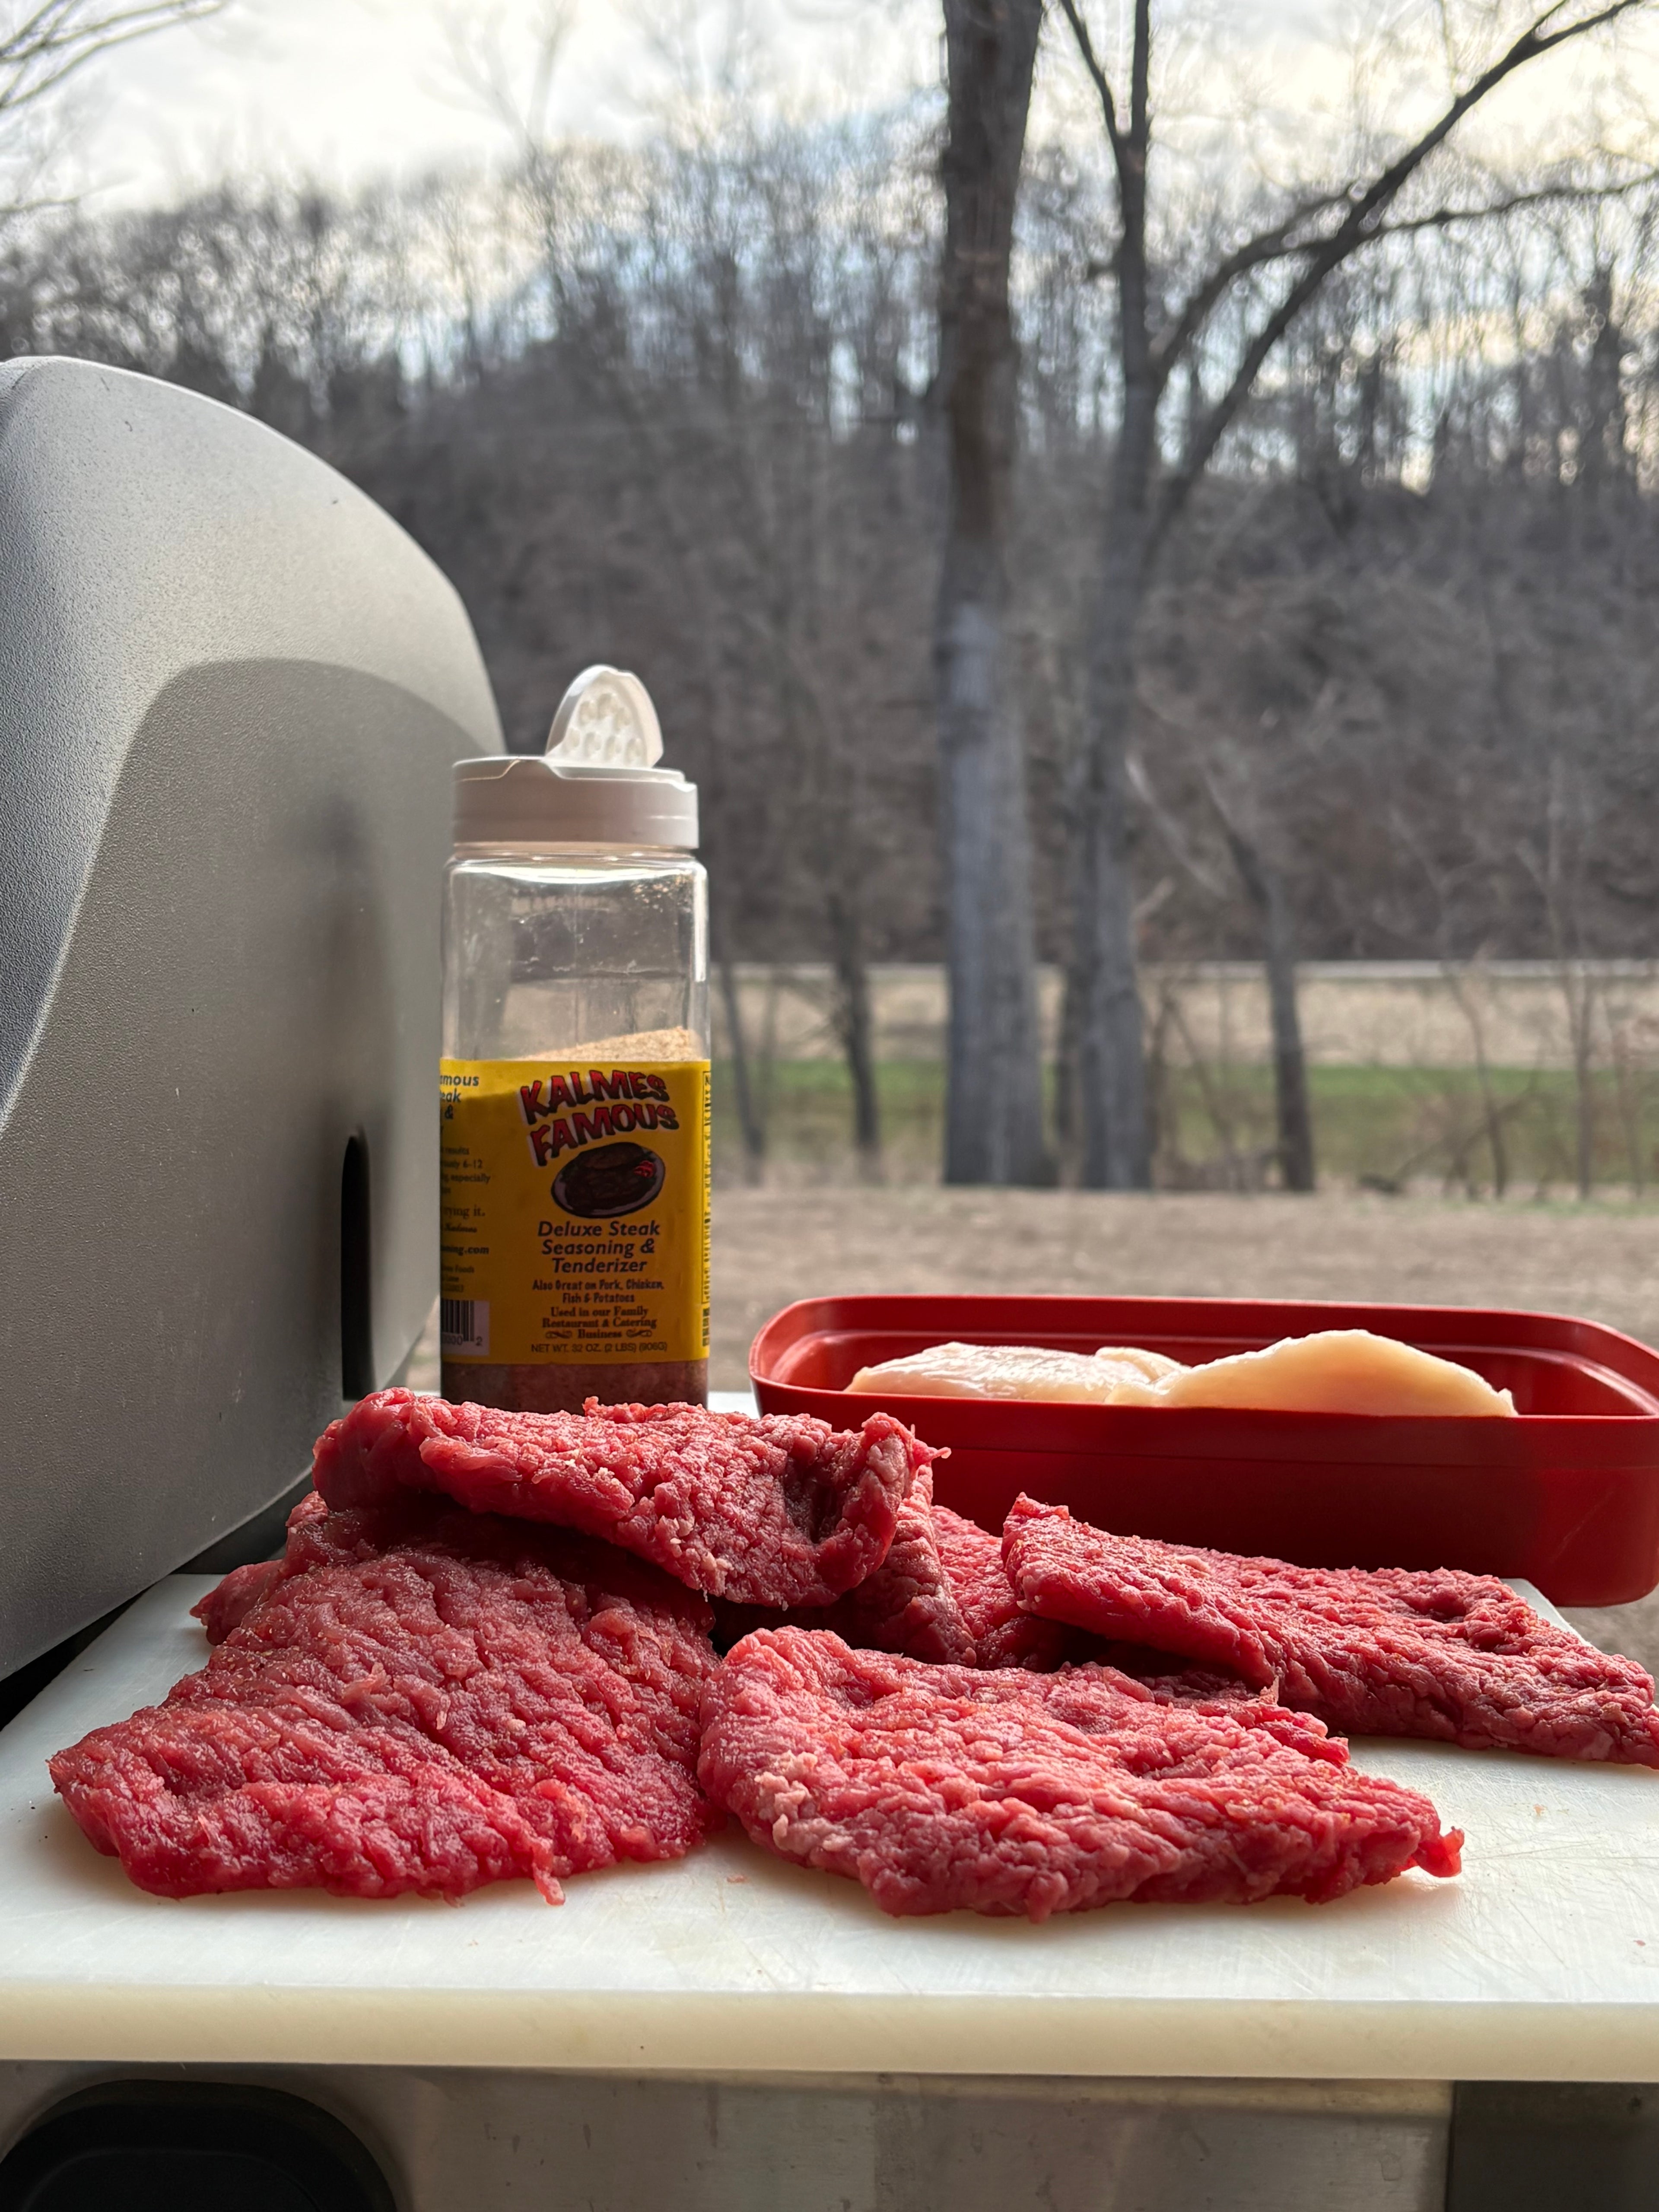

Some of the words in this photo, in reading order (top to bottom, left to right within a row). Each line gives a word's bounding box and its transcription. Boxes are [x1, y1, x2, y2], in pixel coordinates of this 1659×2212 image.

[520, 1070, 670, 1125] KALMES
[445, 1104, 453, 1119] &
[530, 1103, 680, 1166] FAMOUS
[537, 1221, 602, 1237] Deluxe
[608, 1220, 660, 1236] Steak
[541, 1239, 635, 1259] Seasoning
[640, 1238, 655, 1253] &
[552, 1258, 647, 1273] Tenderizer
[532, 1279, 553, 1290] Also
[555, 1280, 583, 1290] Great
[599, 1279, 623, 1290] Pork,
[562, 1292, 581, 1303] Fish
[593, 1292, 635, 1303] Potatoes
[550, 1306, 576, 1317] Used
[579, 1307, 589, 1316] in
[614, 1306, 648, 1319] Family
[542, 1318, 599, 1328] Restaurant
[613, 1317, 657, 1329] Catering
[577, 1329, 623, 1339] Business
[531, 1344, 550, 1353] NET
[572, 1344, 583, 1352] 32
[615, 1342, 636, 1353] LBS)
